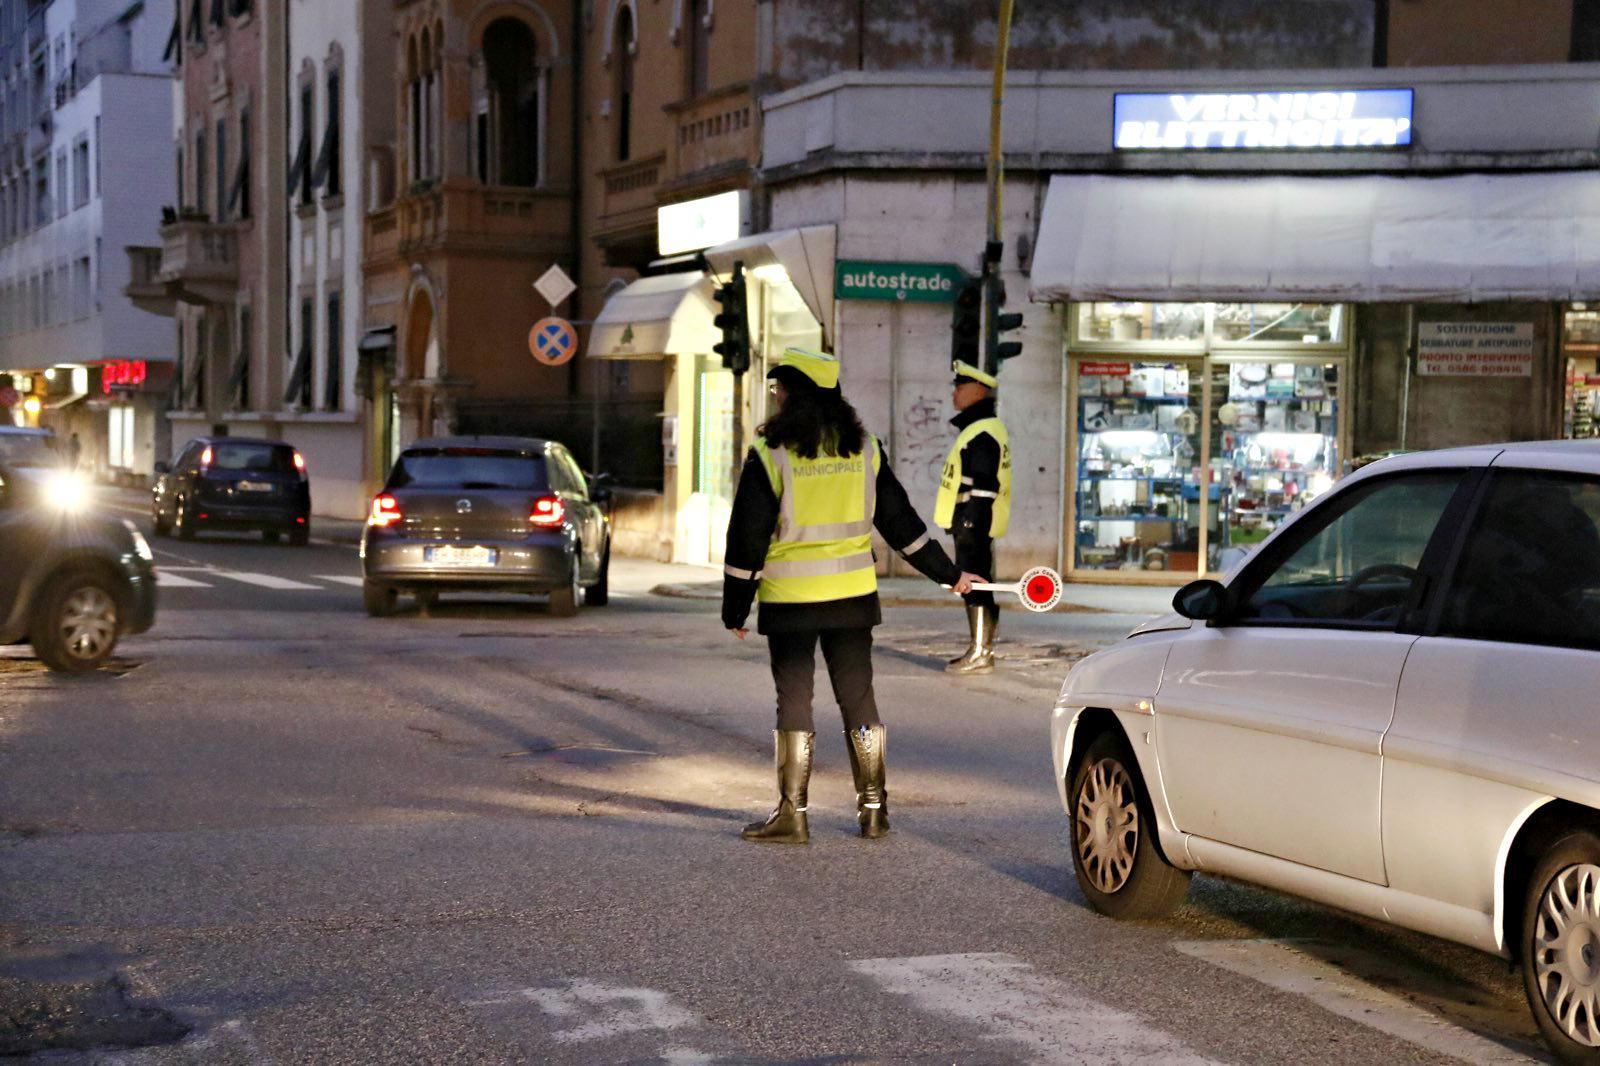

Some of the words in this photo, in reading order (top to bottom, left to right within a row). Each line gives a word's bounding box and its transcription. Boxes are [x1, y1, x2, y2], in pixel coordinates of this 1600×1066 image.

[1170, 92, 1357, 122] VERNICI
[843, 271, 952, 291] autostrade
[1436, 325, 1516, 334] SOSTITUZIONE
[1419, 353, 1463, 362] PRONTO
[793, 462, 863, 477] MUNICIPALE
